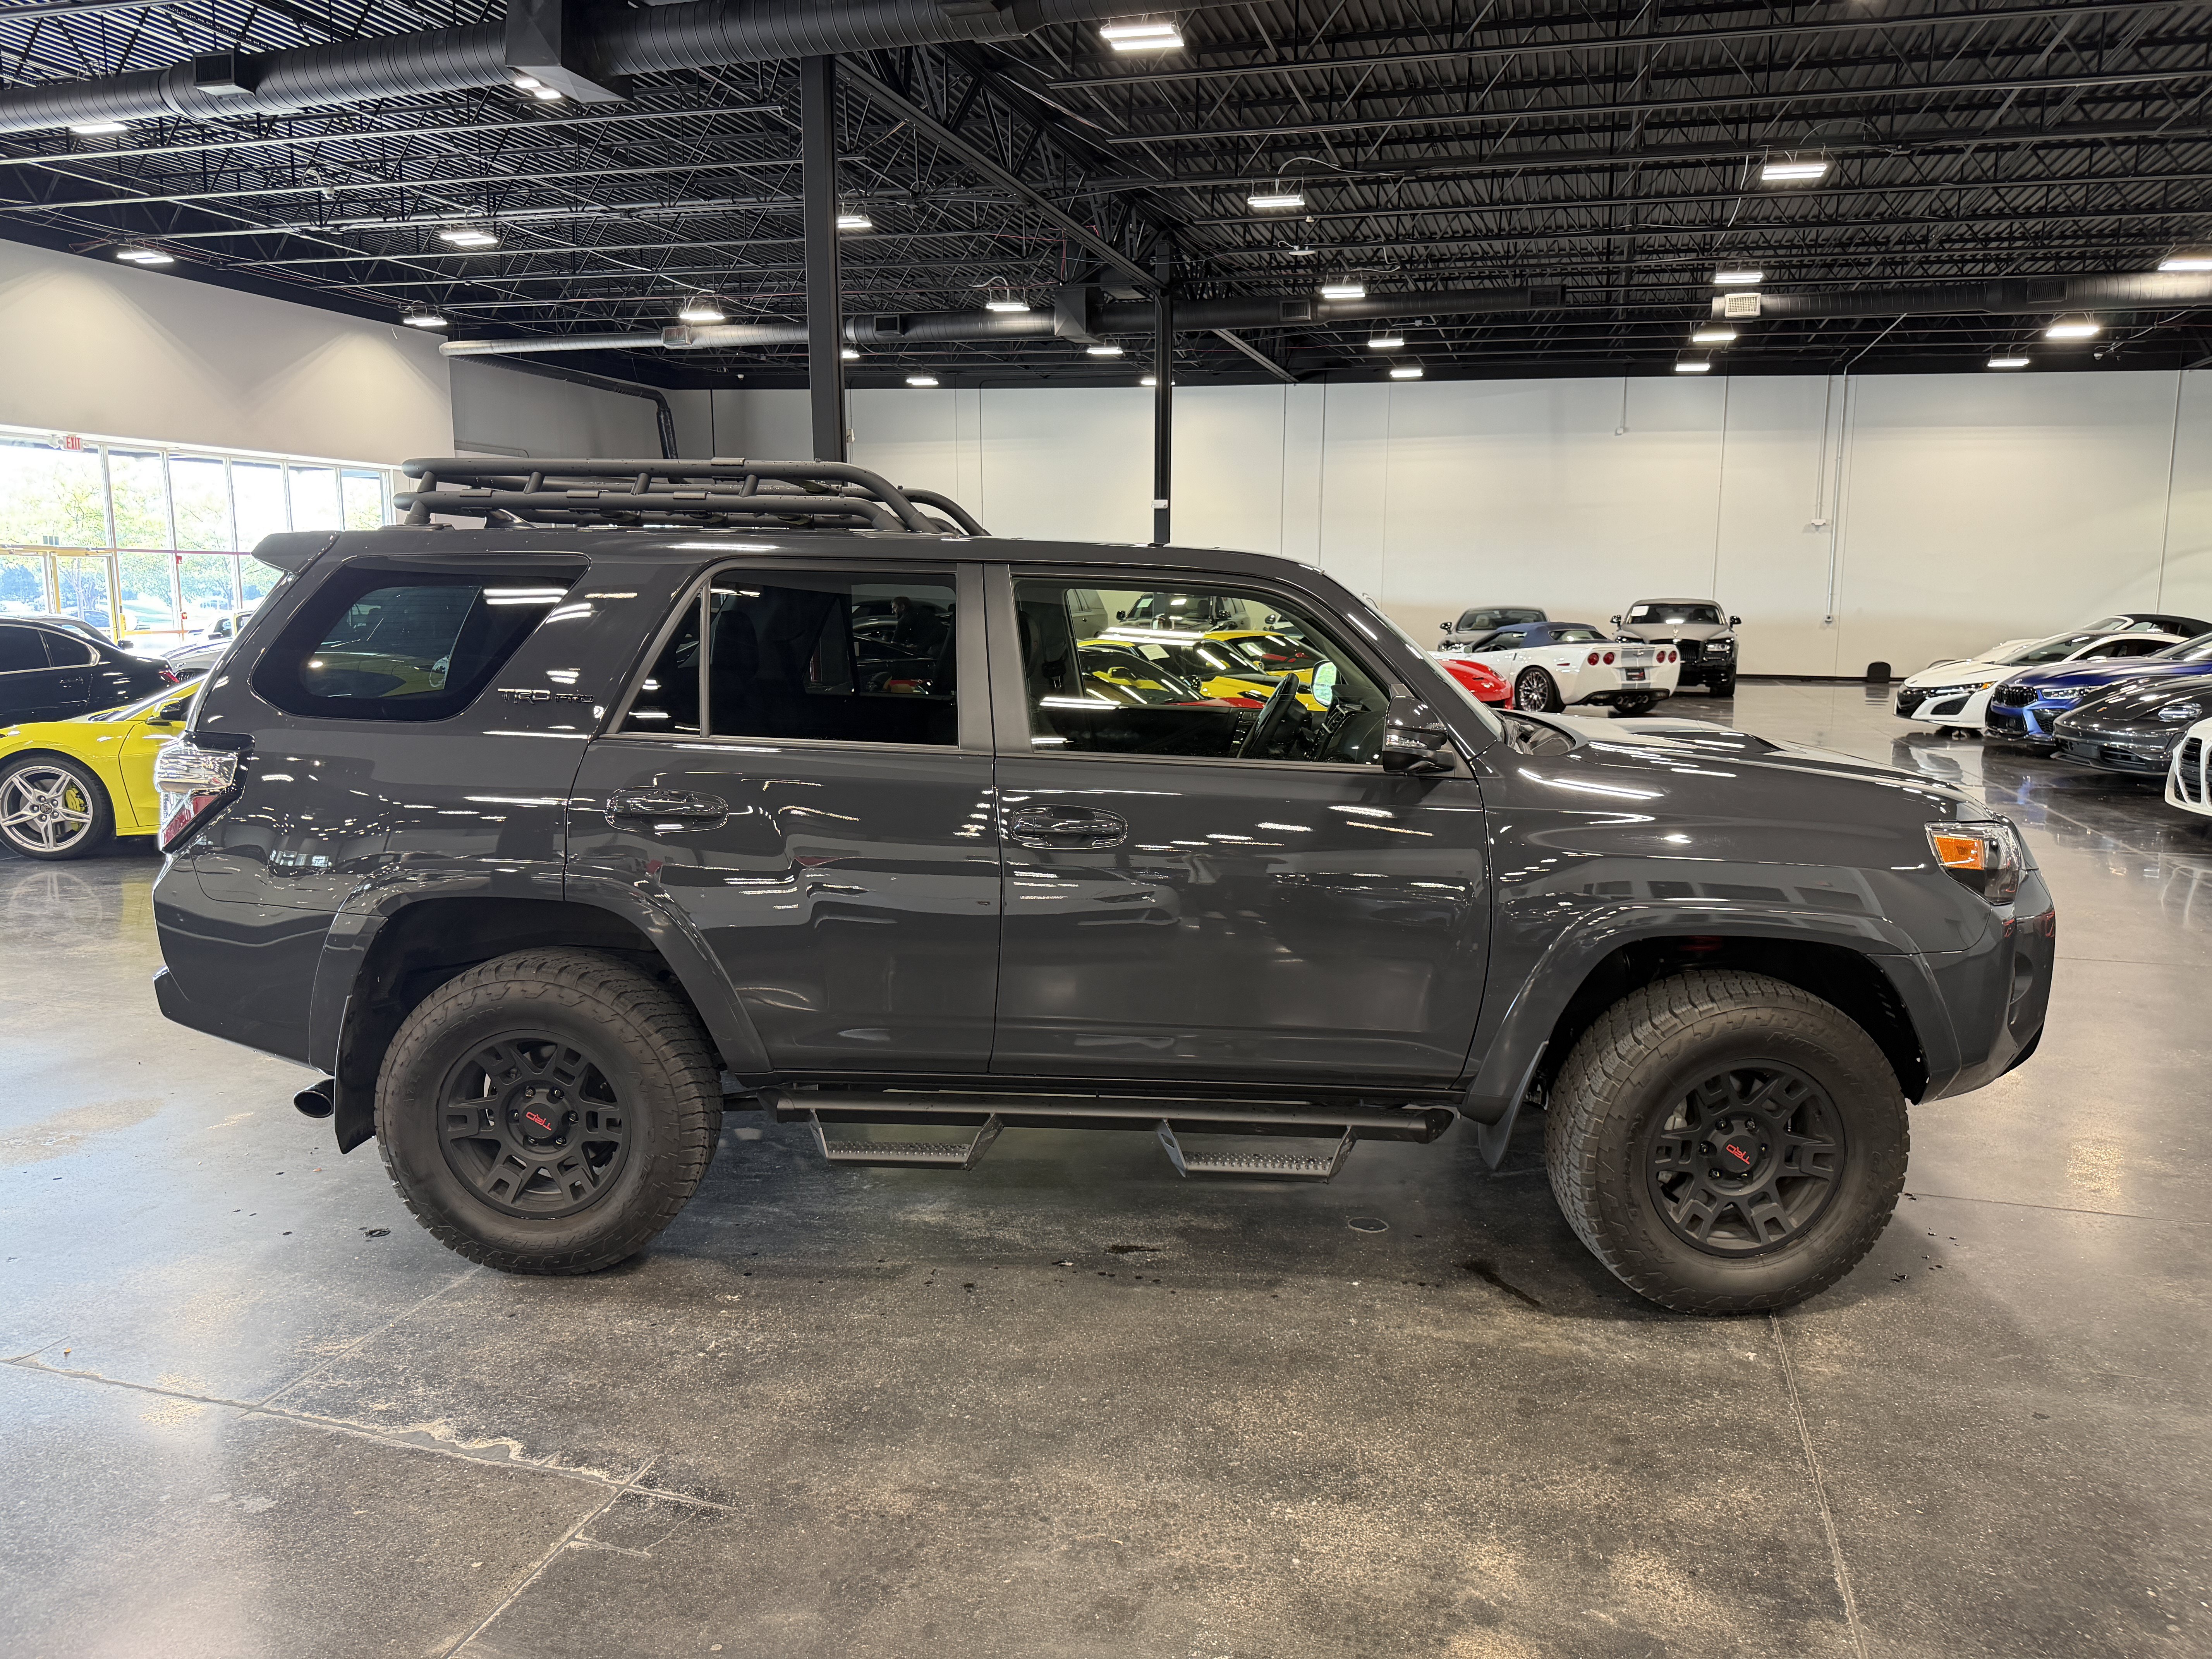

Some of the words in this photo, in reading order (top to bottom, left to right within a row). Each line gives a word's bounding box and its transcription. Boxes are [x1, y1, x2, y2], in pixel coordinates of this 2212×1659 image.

[66, 436, 81, 450] EXIT
[498, 688, 552, 705] TRD
[526, 1111, 552, 1131] TRD
[1726, 1144, 1751, 1165] TRD
